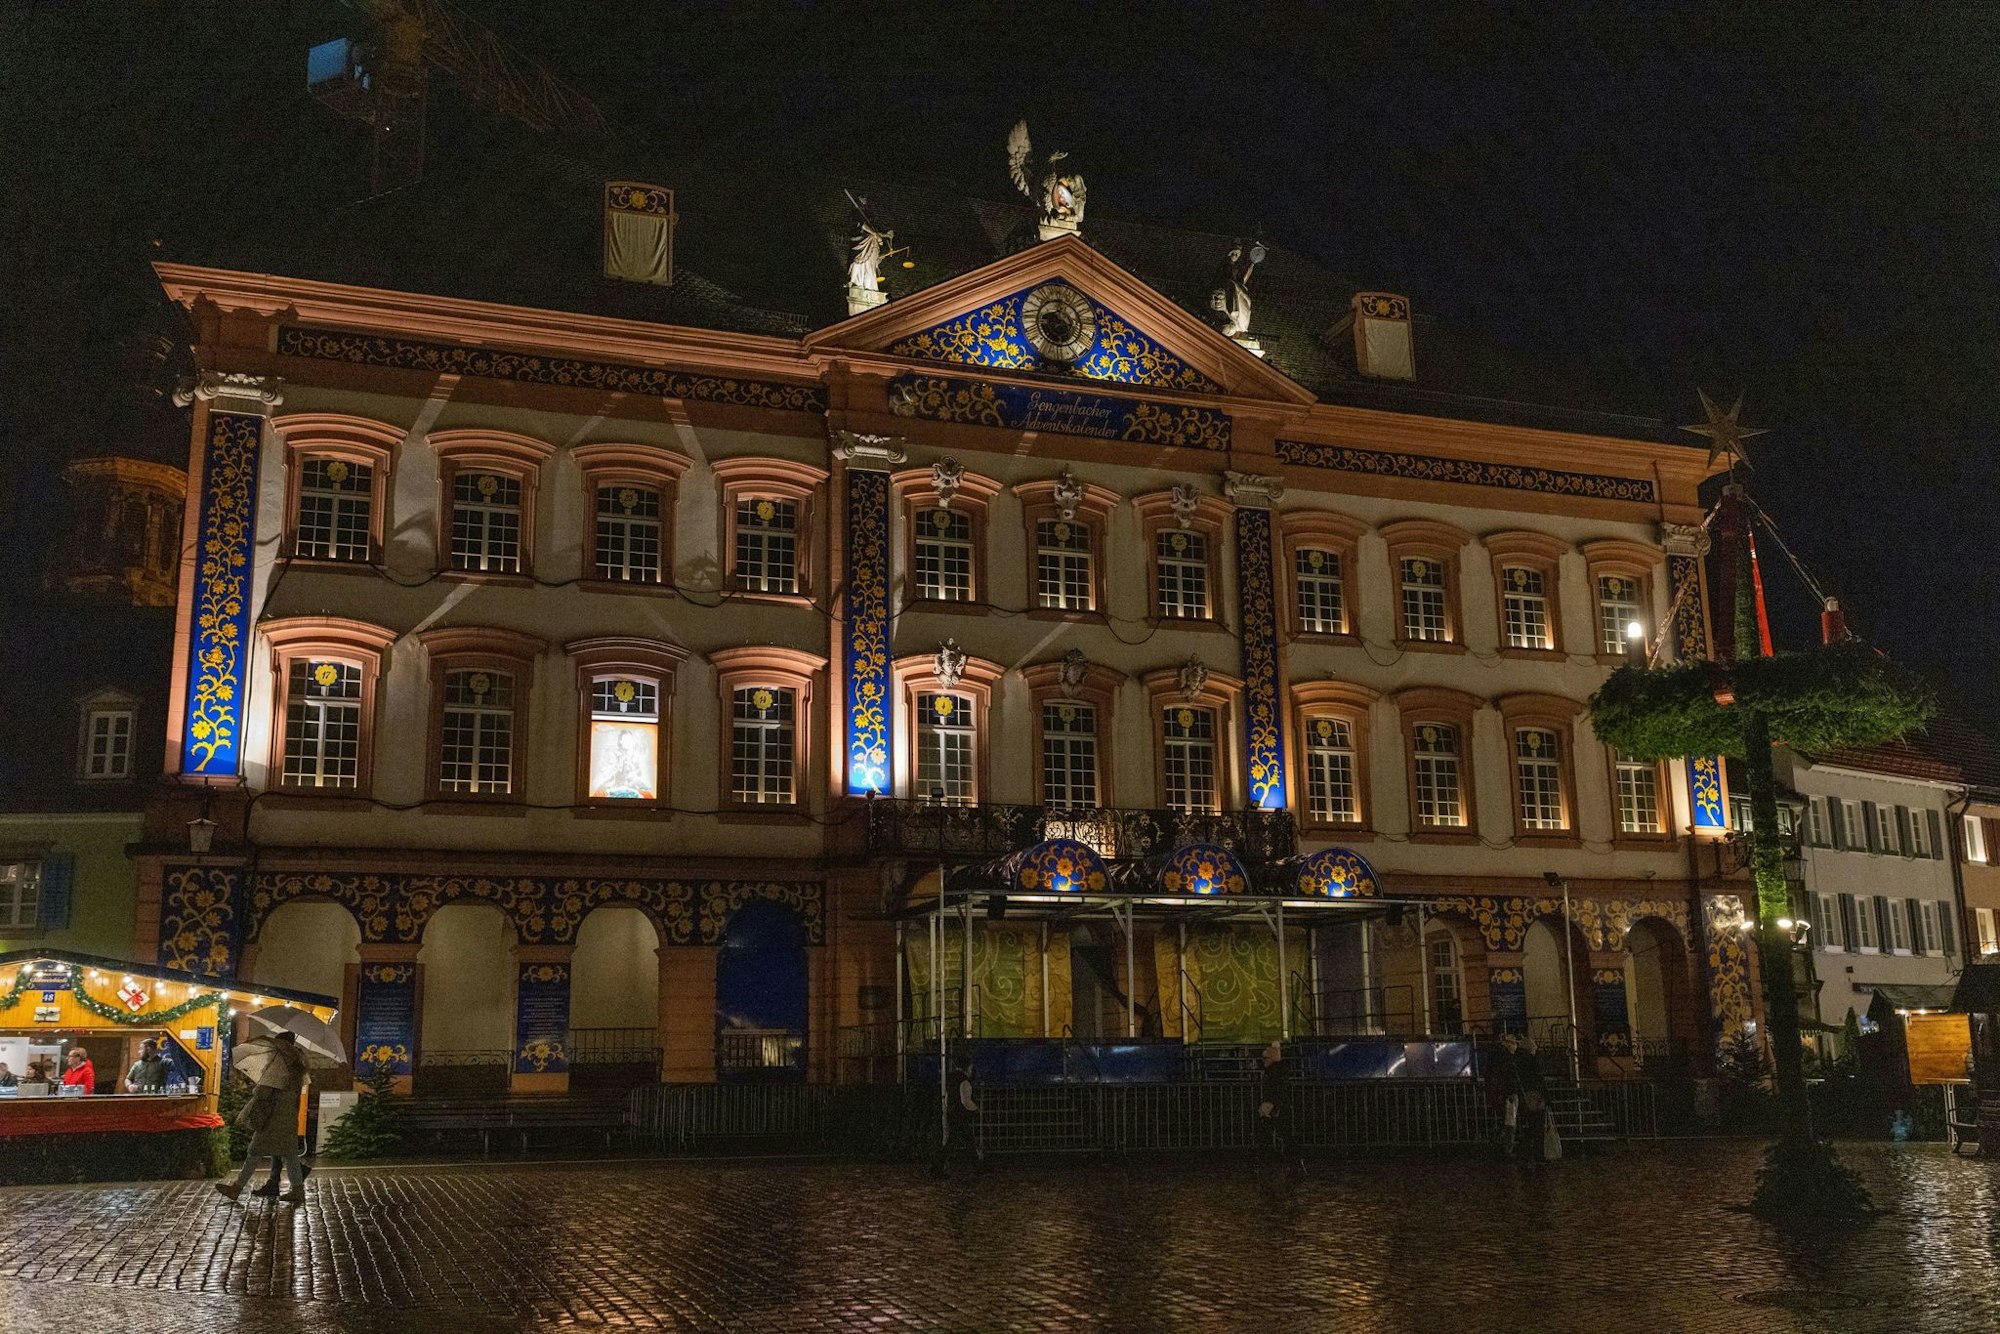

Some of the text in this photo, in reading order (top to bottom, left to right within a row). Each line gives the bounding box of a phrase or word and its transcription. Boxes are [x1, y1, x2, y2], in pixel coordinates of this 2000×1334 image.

[1010, 411, 1118, 439] Adventskalender
[764, 507, 771, 516] 7
[322, 670, 332, 681] 17
